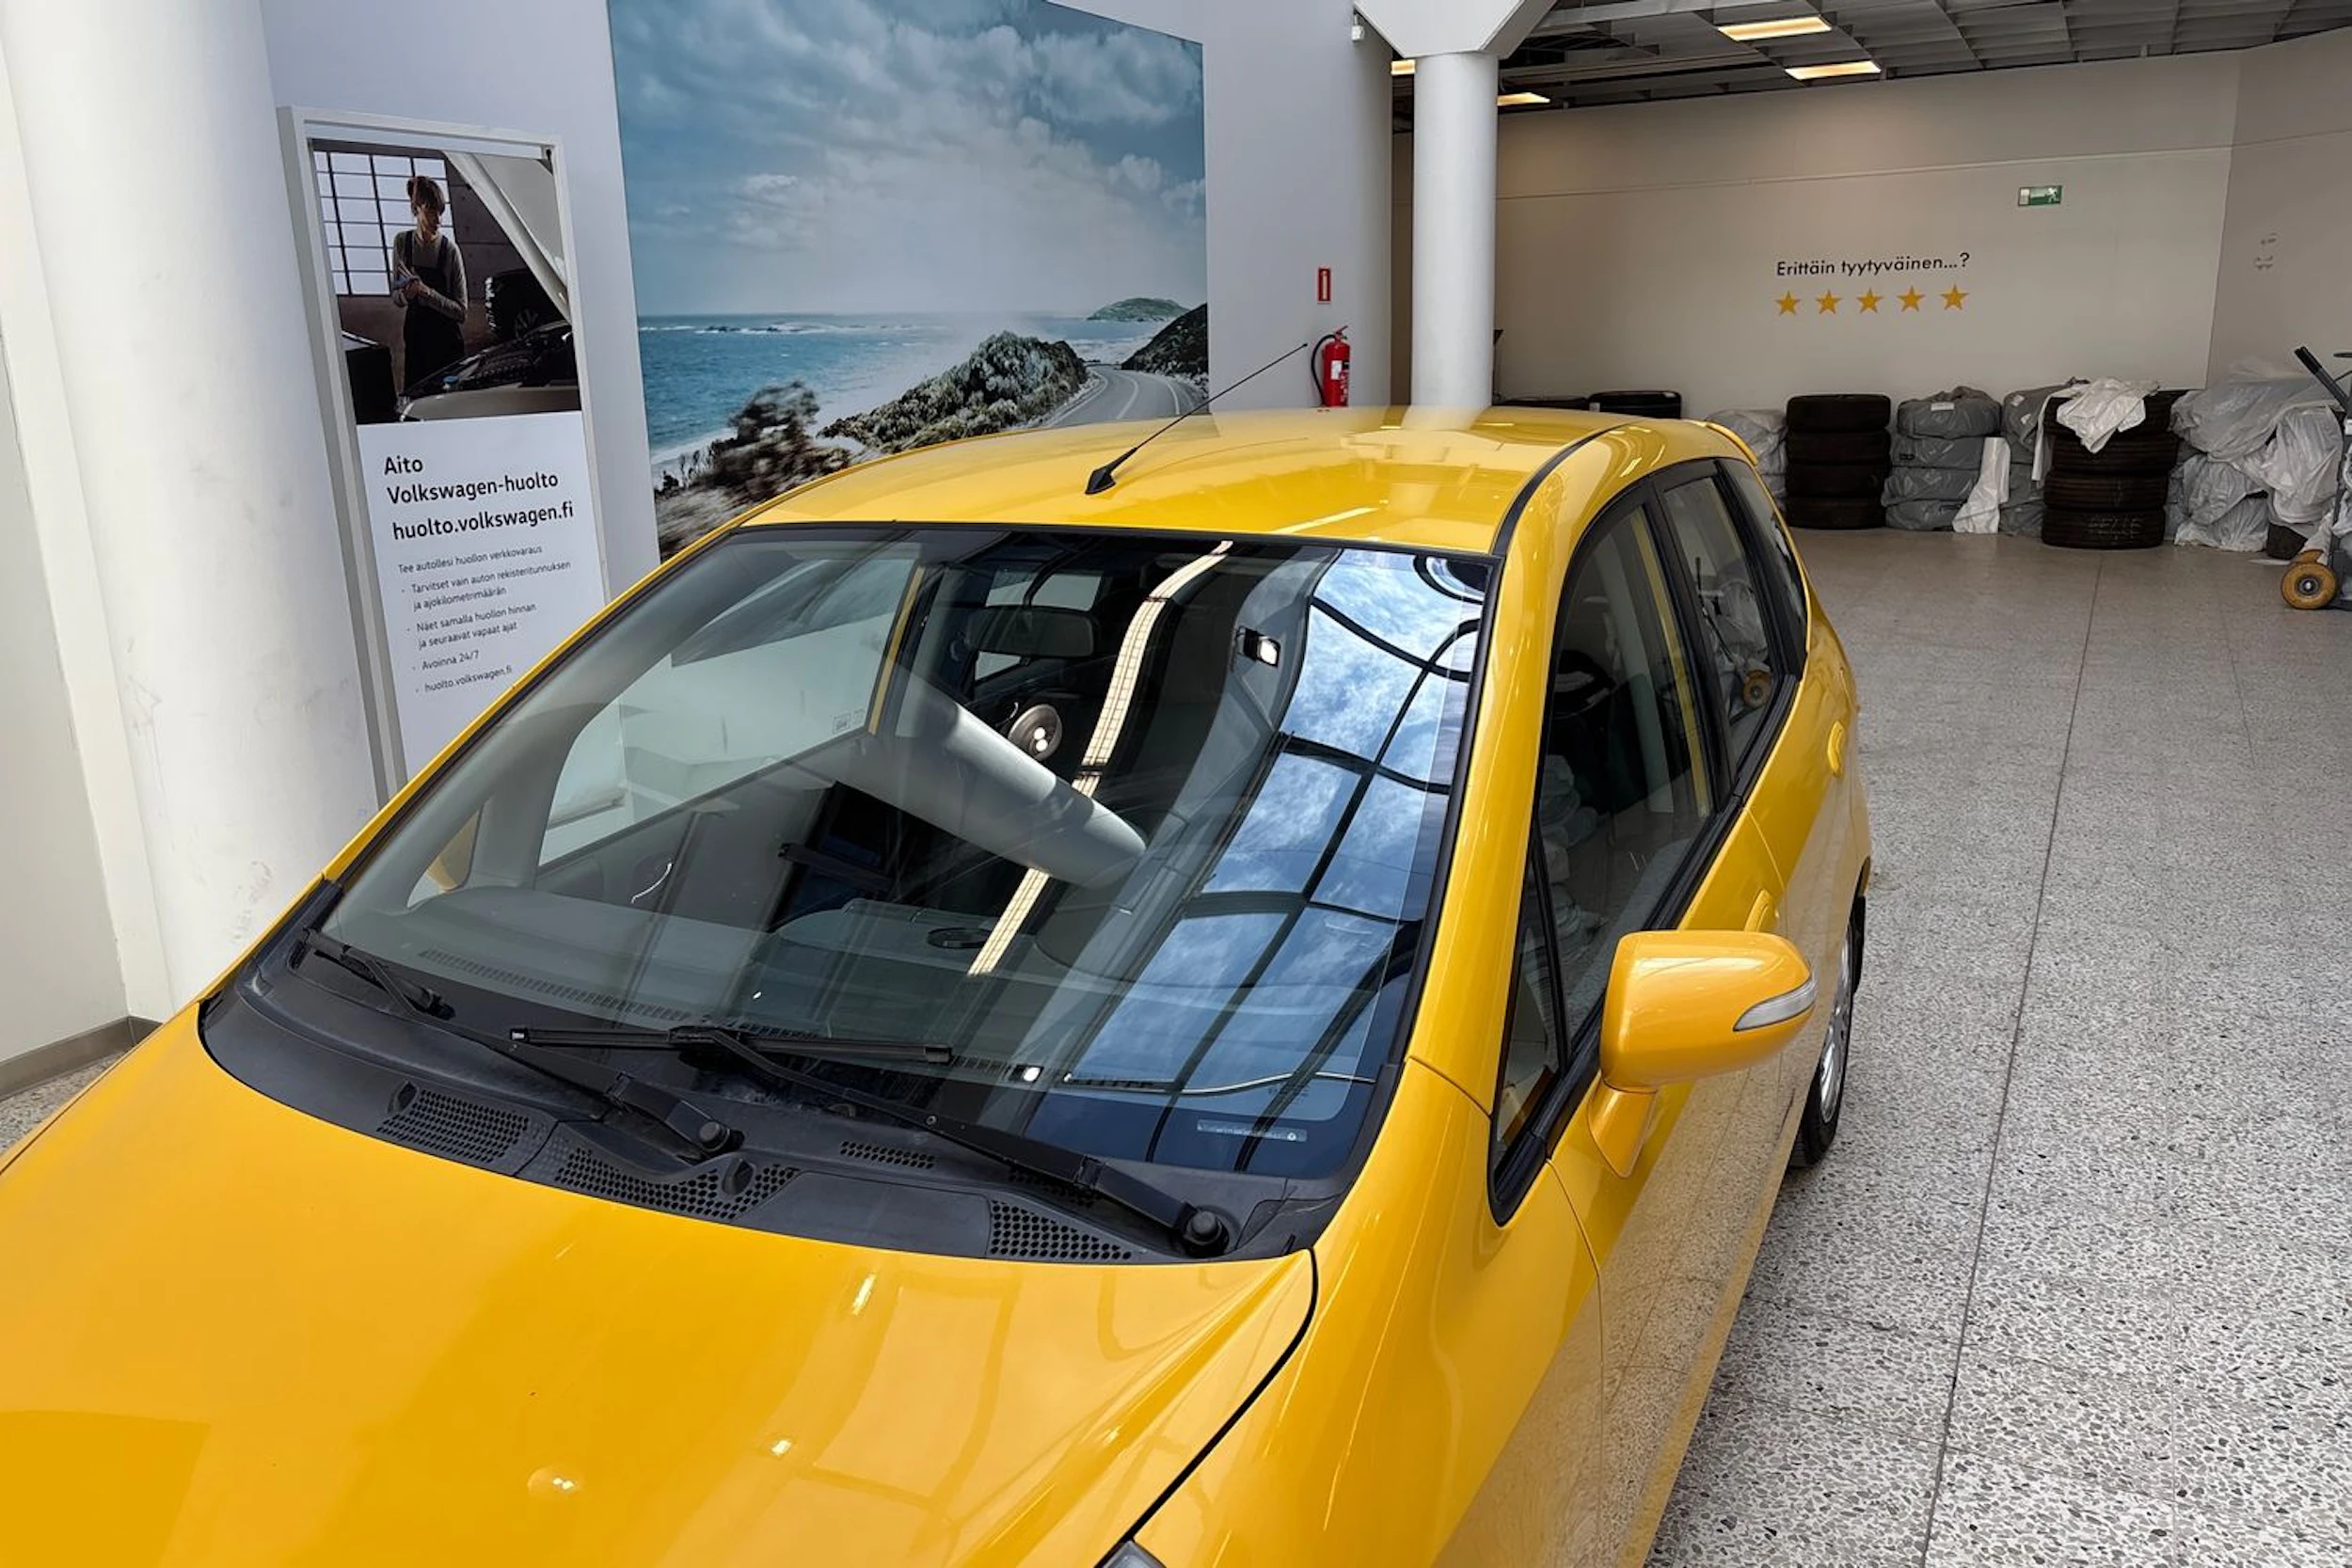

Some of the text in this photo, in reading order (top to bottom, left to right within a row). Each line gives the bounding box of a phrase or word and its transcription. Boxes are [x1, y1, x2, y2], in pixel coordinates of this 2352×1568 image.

[1776, 252, 1970, 277] Erittäin tyytyväinen...?
[384, 455, 423, 475] Aito
[387, 471, 559, 504] Volkswagen-huolto
[392, 500, 574, 540] huolto.volkswagen.fi
[398, 546, 543, 574] Tee autollesi huollon verkkovaraus
[412, 562, 571, 594] Tarvitset vain auton rekisteritunnuksen
[414, 601, 421, 612] ja
[440, 614, 473, 627] samalla
[475, 609, 507, 622] huollon
[508, 604, 536, 615] hinnan
[419, 622, 517, 651] ja seuraavat vapaat ajat
[421, 649, 479, 671] Avoinna 24/7
[424, 665, 513, 692] huolto.volkswagen.fi
